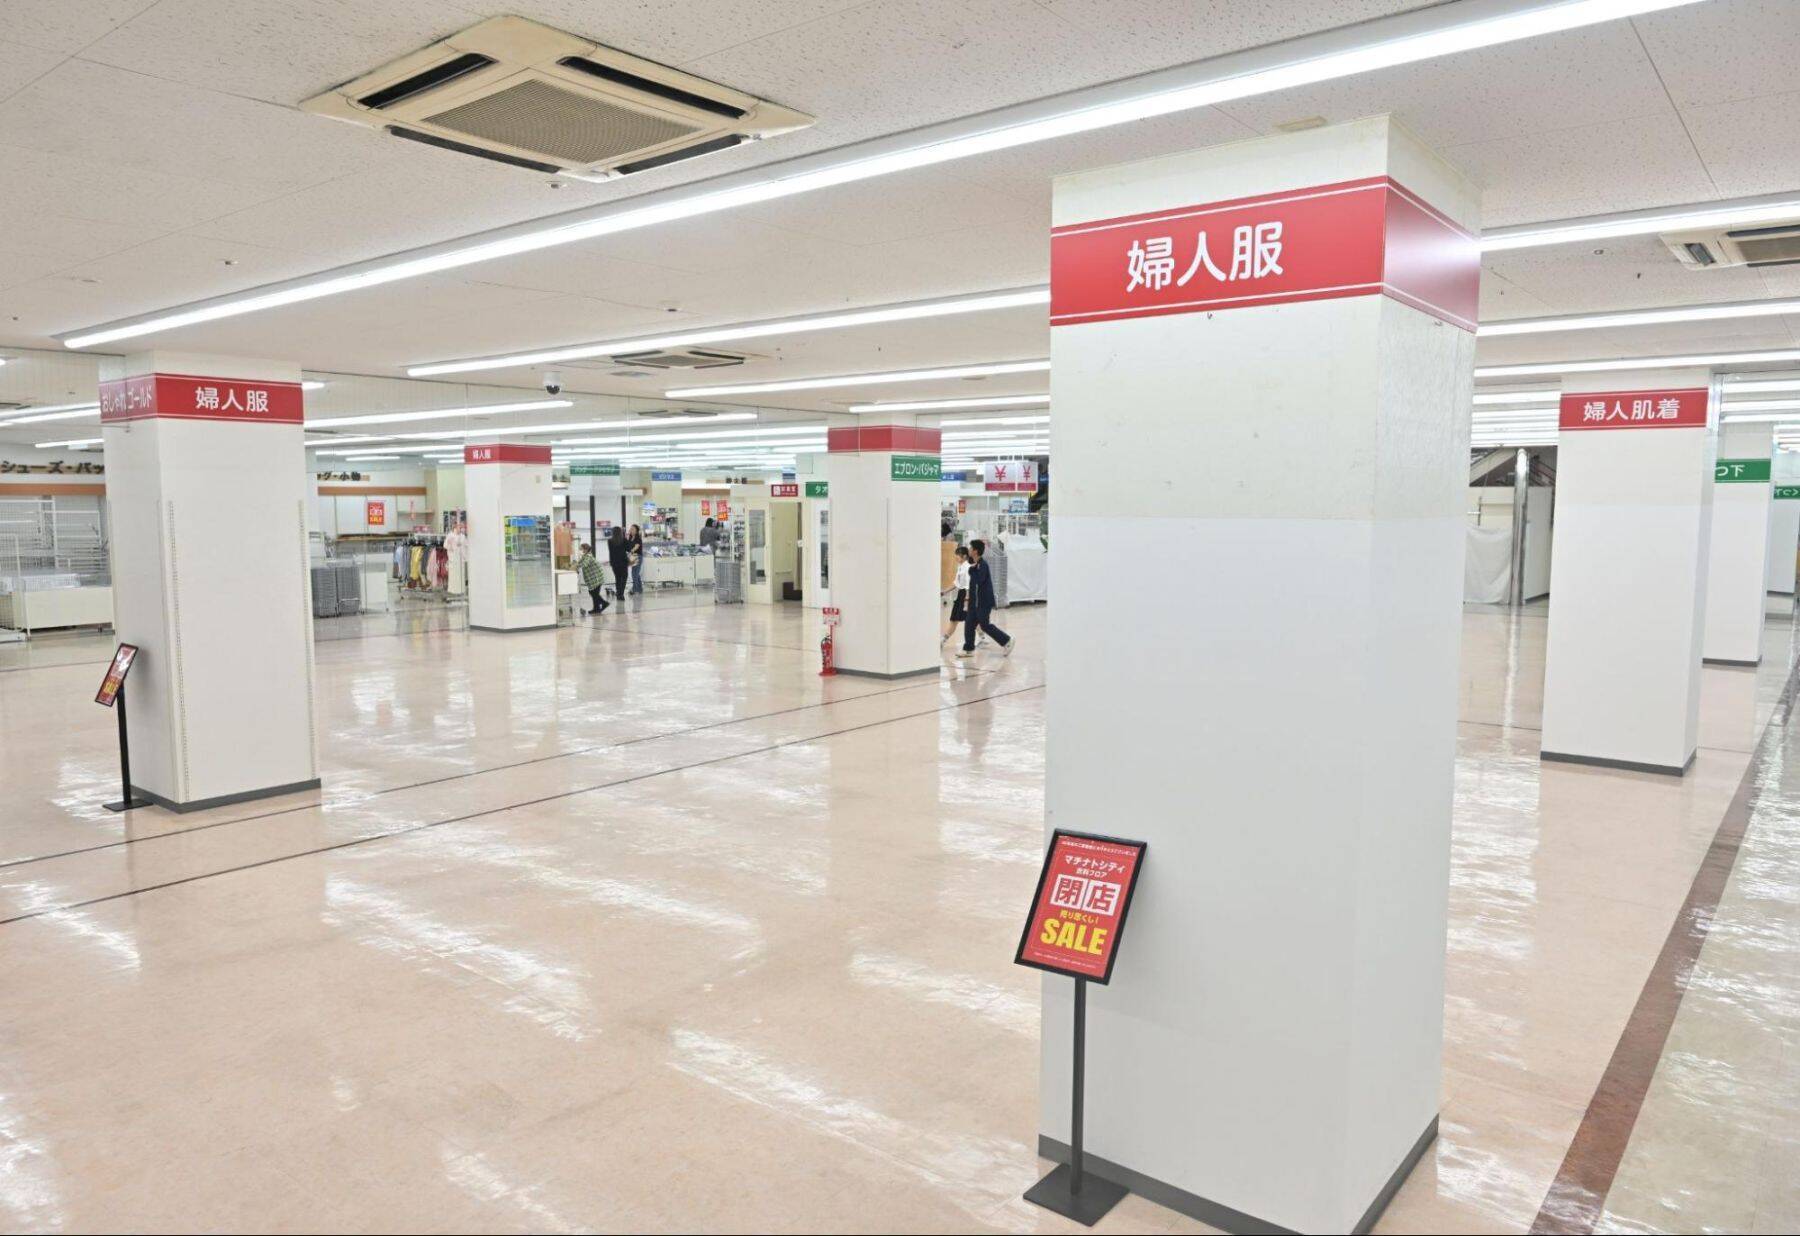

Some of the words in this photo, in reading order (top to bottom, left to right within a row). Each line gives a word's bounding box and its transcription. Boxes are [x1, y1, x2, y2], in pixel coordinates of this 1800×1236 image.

[1126, 221, 1284, 293] 婦人服
[194, 386, 270, 413] 婦人服
[1583, 398, 1681, 424] 婦人肌着
[894, 461, 940, 476] エプロン・パジャマ
[1064, 855, 1126, 873] マチナトシティ
[1053, 877, 1116, 913] 閉店
[1040, 918, 1108, 956] SALE
